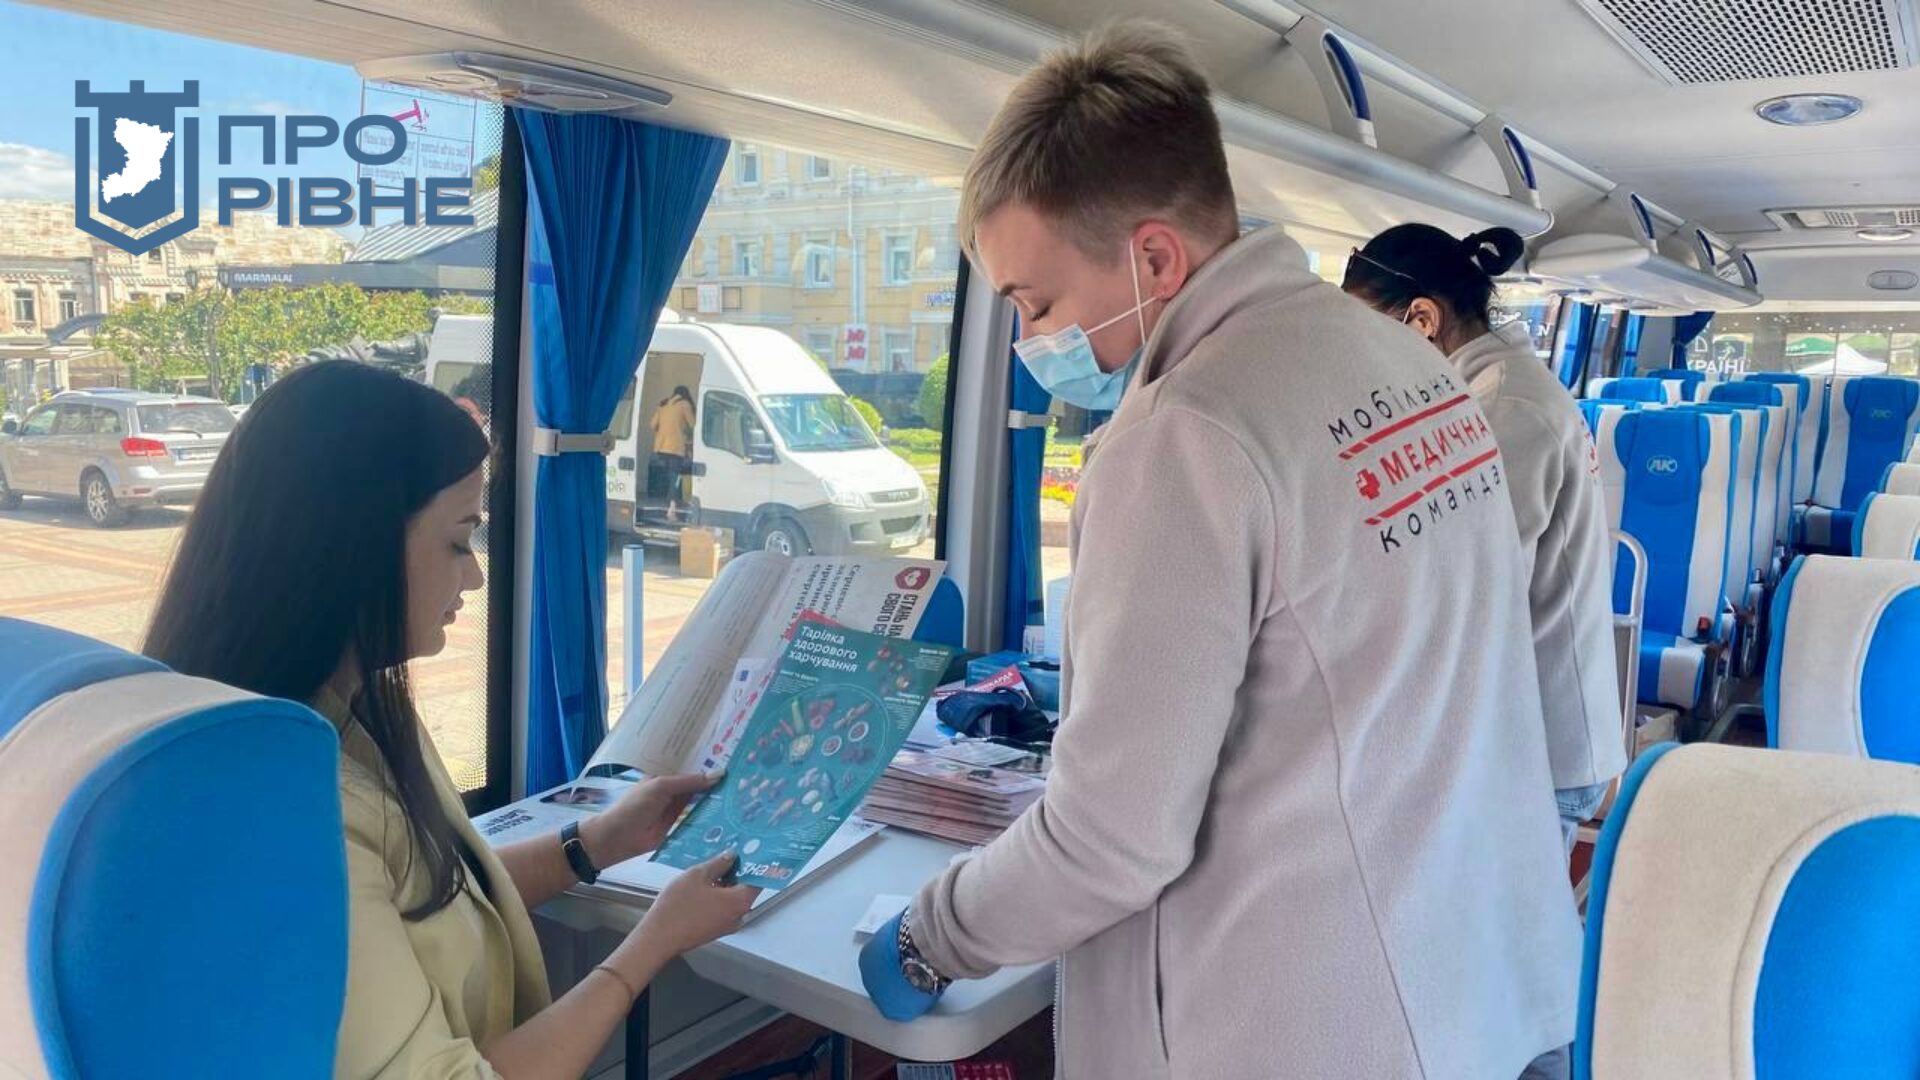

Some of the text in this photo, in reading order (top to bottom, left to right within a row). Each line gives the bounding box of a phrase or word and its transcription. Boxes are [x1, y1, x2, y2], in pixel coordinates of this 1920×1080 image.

[1379, 413, 1491, 486] МЕДИЧНА
[877, 592, 901, 622] СВОГО
[893, 593, 919, 624] СТАНЬ
[800, 625, 846, 646] Тарілка
[787, 650, 859, 673] харчування
[793, 639, 859, 661] здорового
